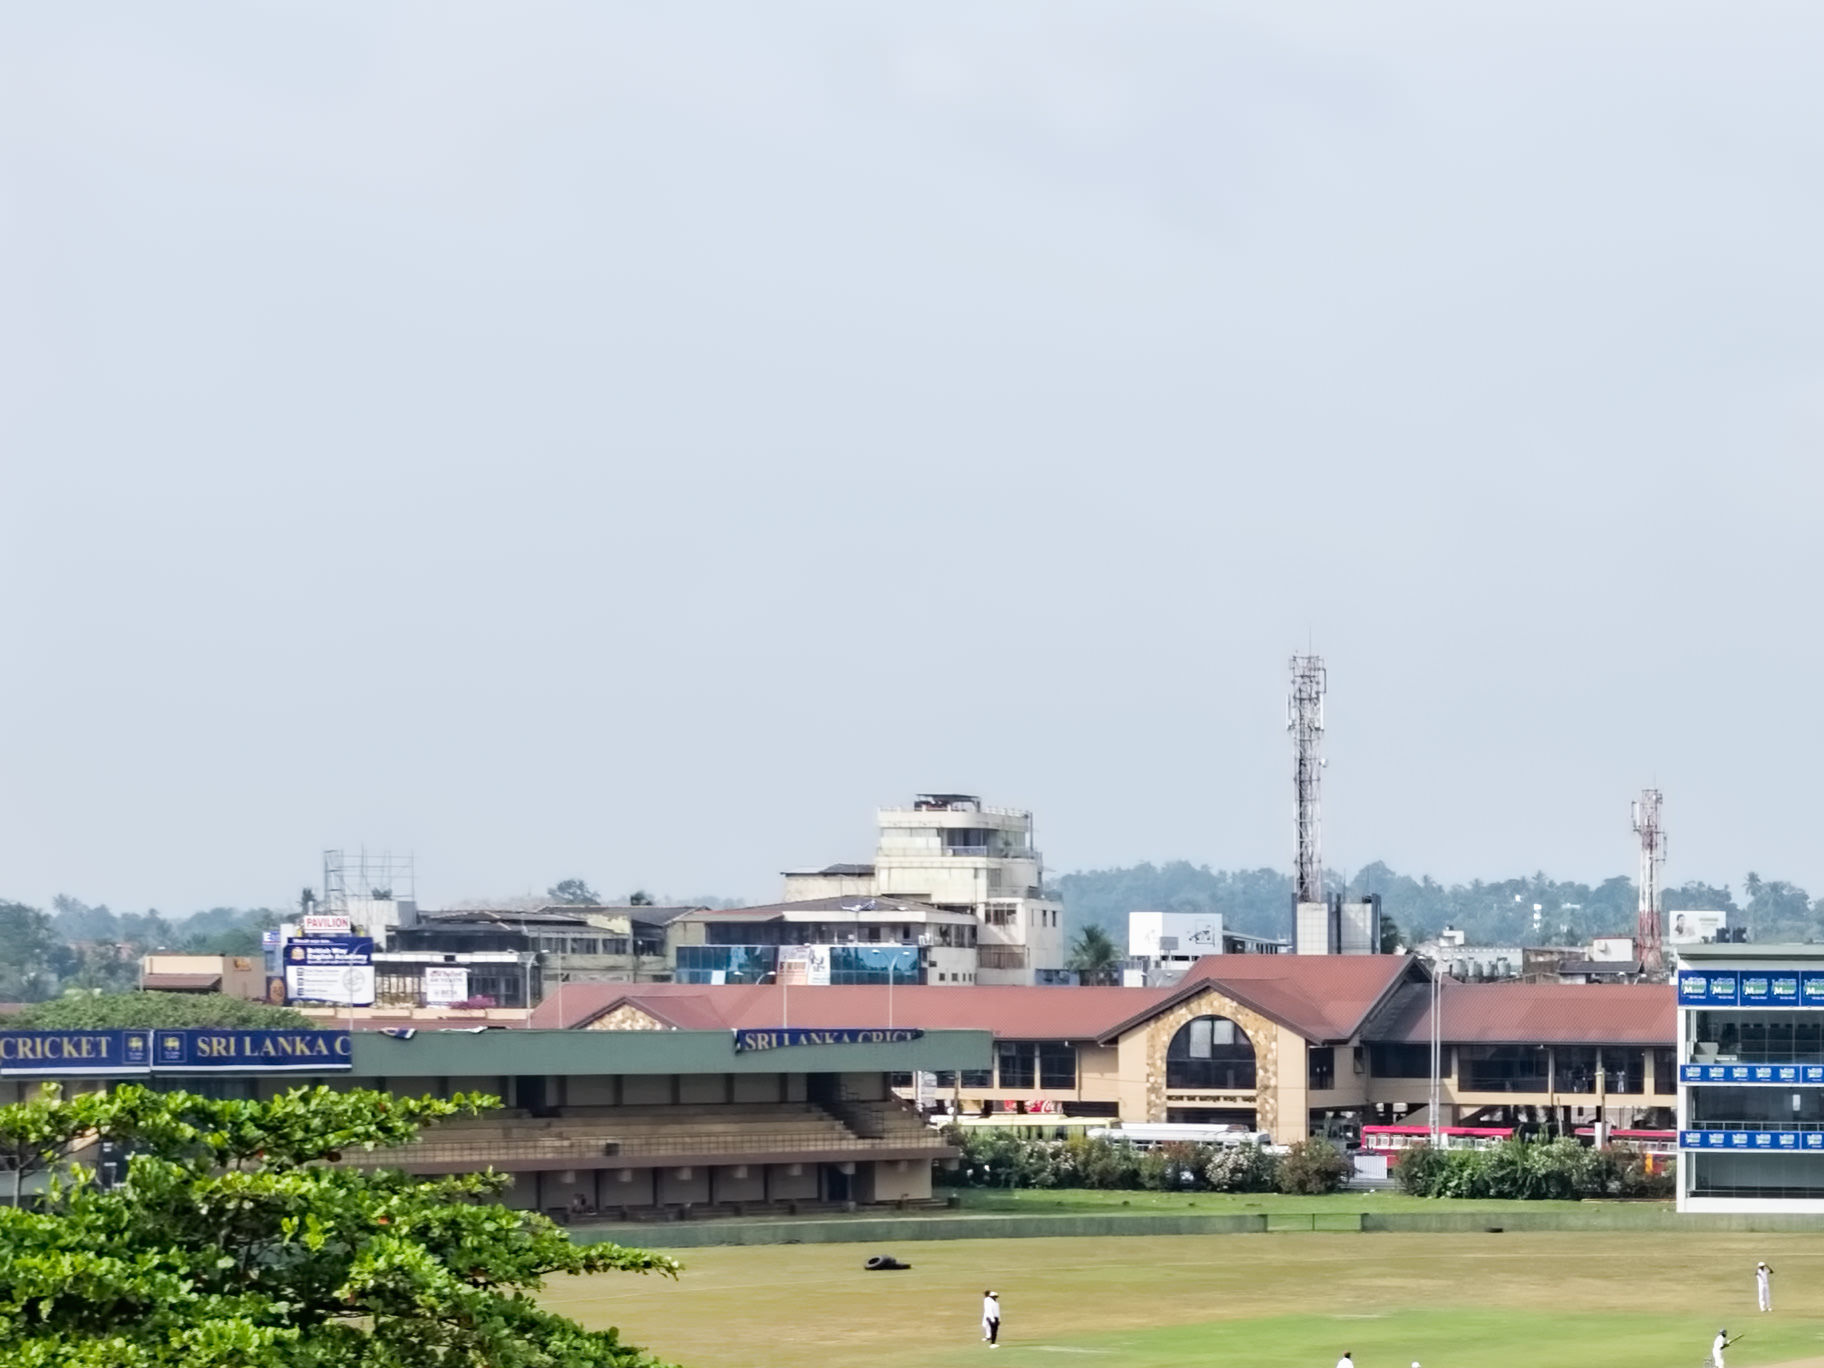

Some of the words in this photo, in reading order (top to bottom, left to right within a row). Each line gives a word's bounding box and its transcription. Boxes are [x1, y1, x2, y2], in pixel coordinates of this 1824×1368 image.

[306, 918, 348, 927] PAVILION
[0, 1036, 112, 1060] CRICKET
[197, 1036, 236, 1057] SRI
[244, 1036, 329, 1057] LANKA
